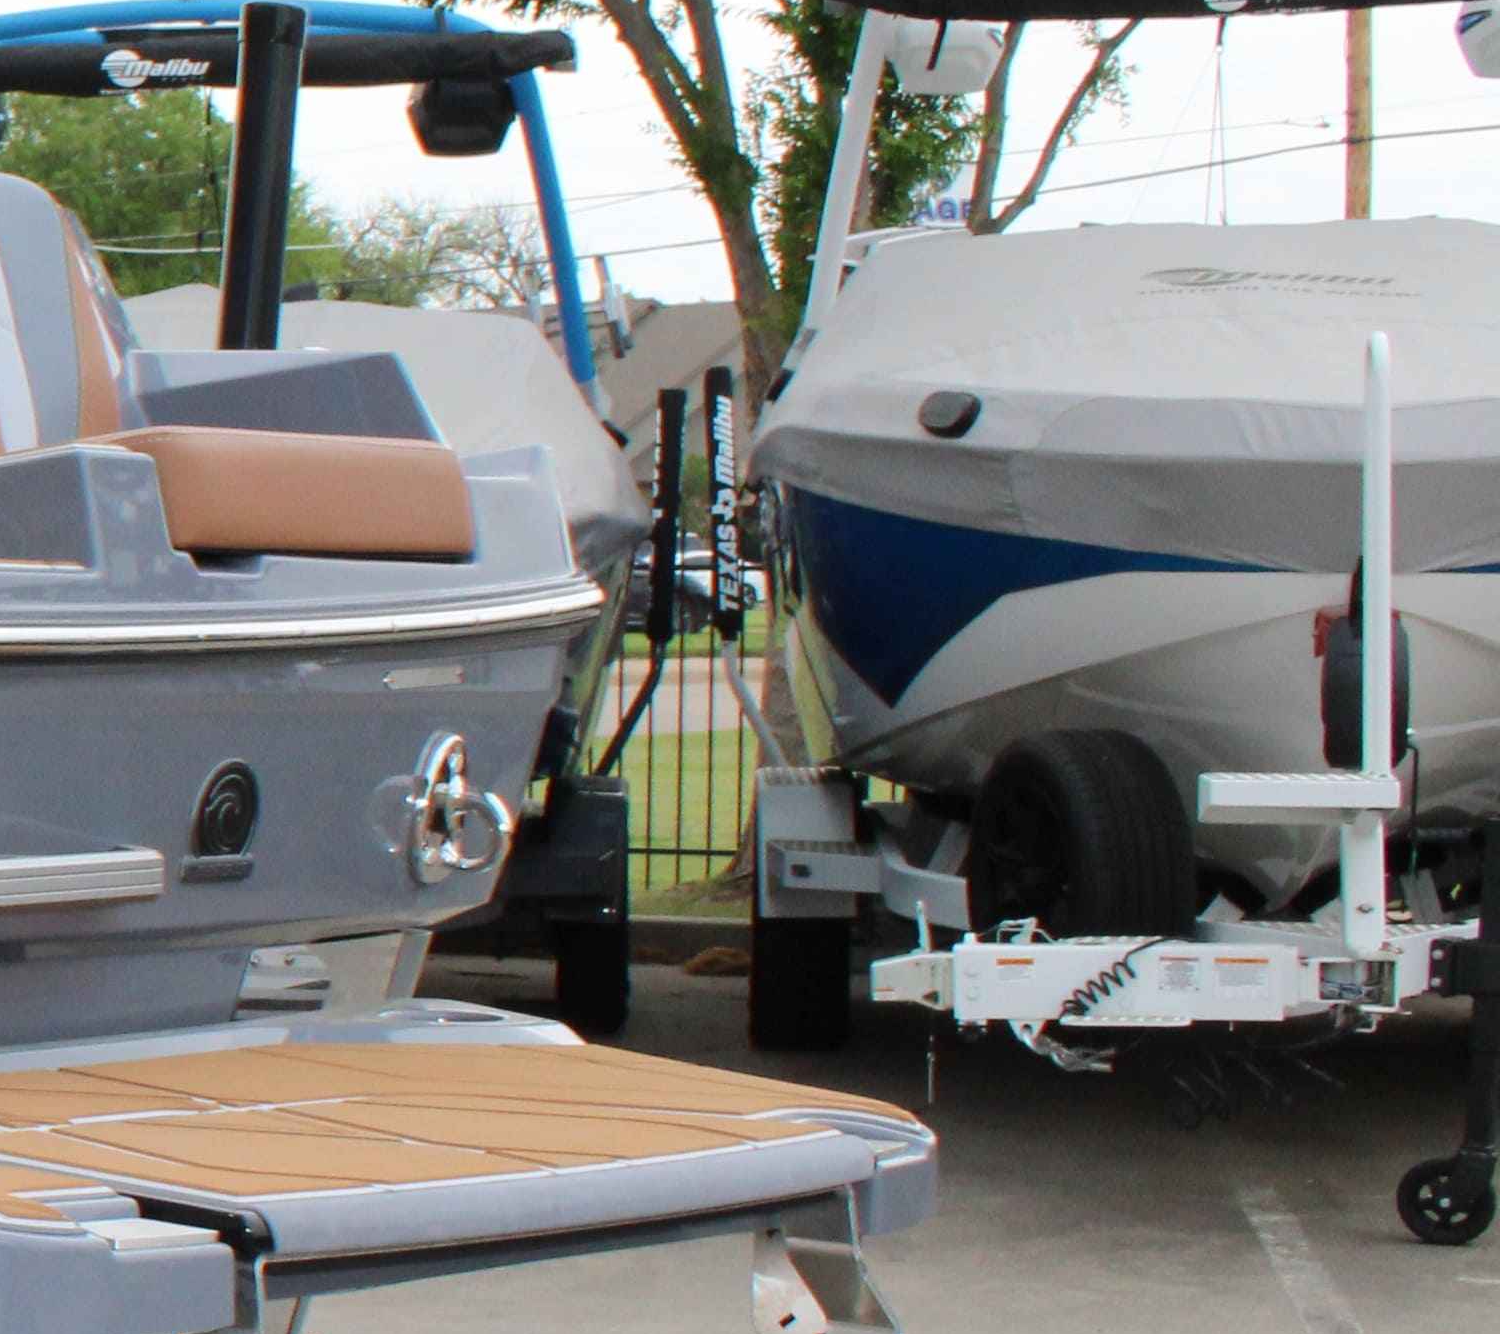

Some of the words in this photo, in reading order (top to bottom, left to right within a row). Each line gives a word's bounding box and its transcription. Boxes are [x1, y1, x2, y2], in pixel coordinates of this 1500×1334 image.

[122, 58, 211, 77] Malibu
[713, 394, 736, 486] Malibu
[717, 523, 741, 612] TEXAS
